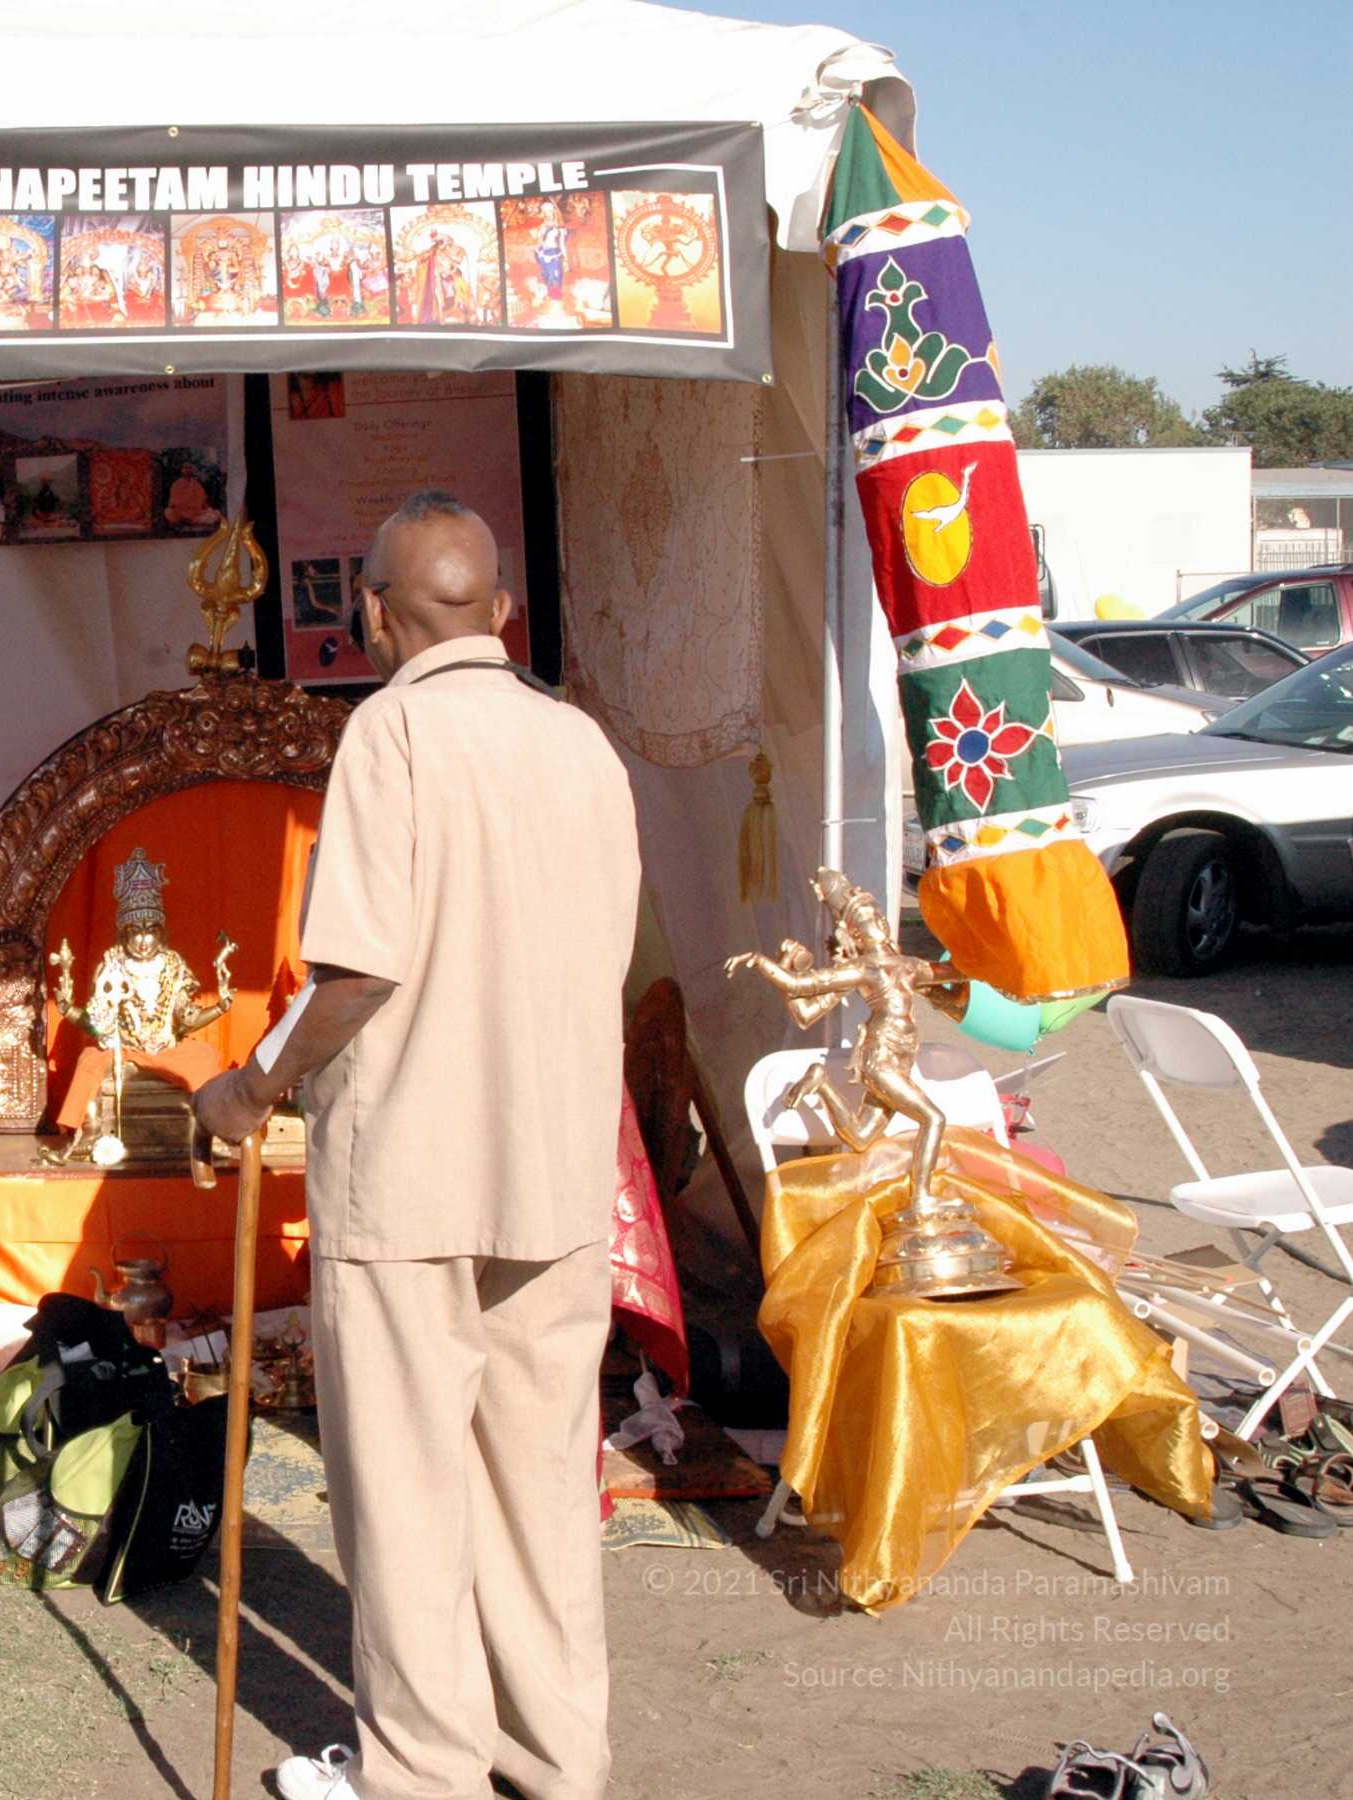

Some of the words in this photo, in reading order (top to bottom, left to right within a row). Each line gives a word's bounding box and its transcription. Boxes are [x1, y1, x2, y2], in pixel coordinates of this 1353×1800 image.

[243, 164, 395, 209] HINDU
[406, 161, 589, 201] TEMPLE
[38, 388, 90, 402] intense
[94, 381, 170, 398] awareness
[174, 376, 215, 390] about
[353, 420, 380, 433] Daily
